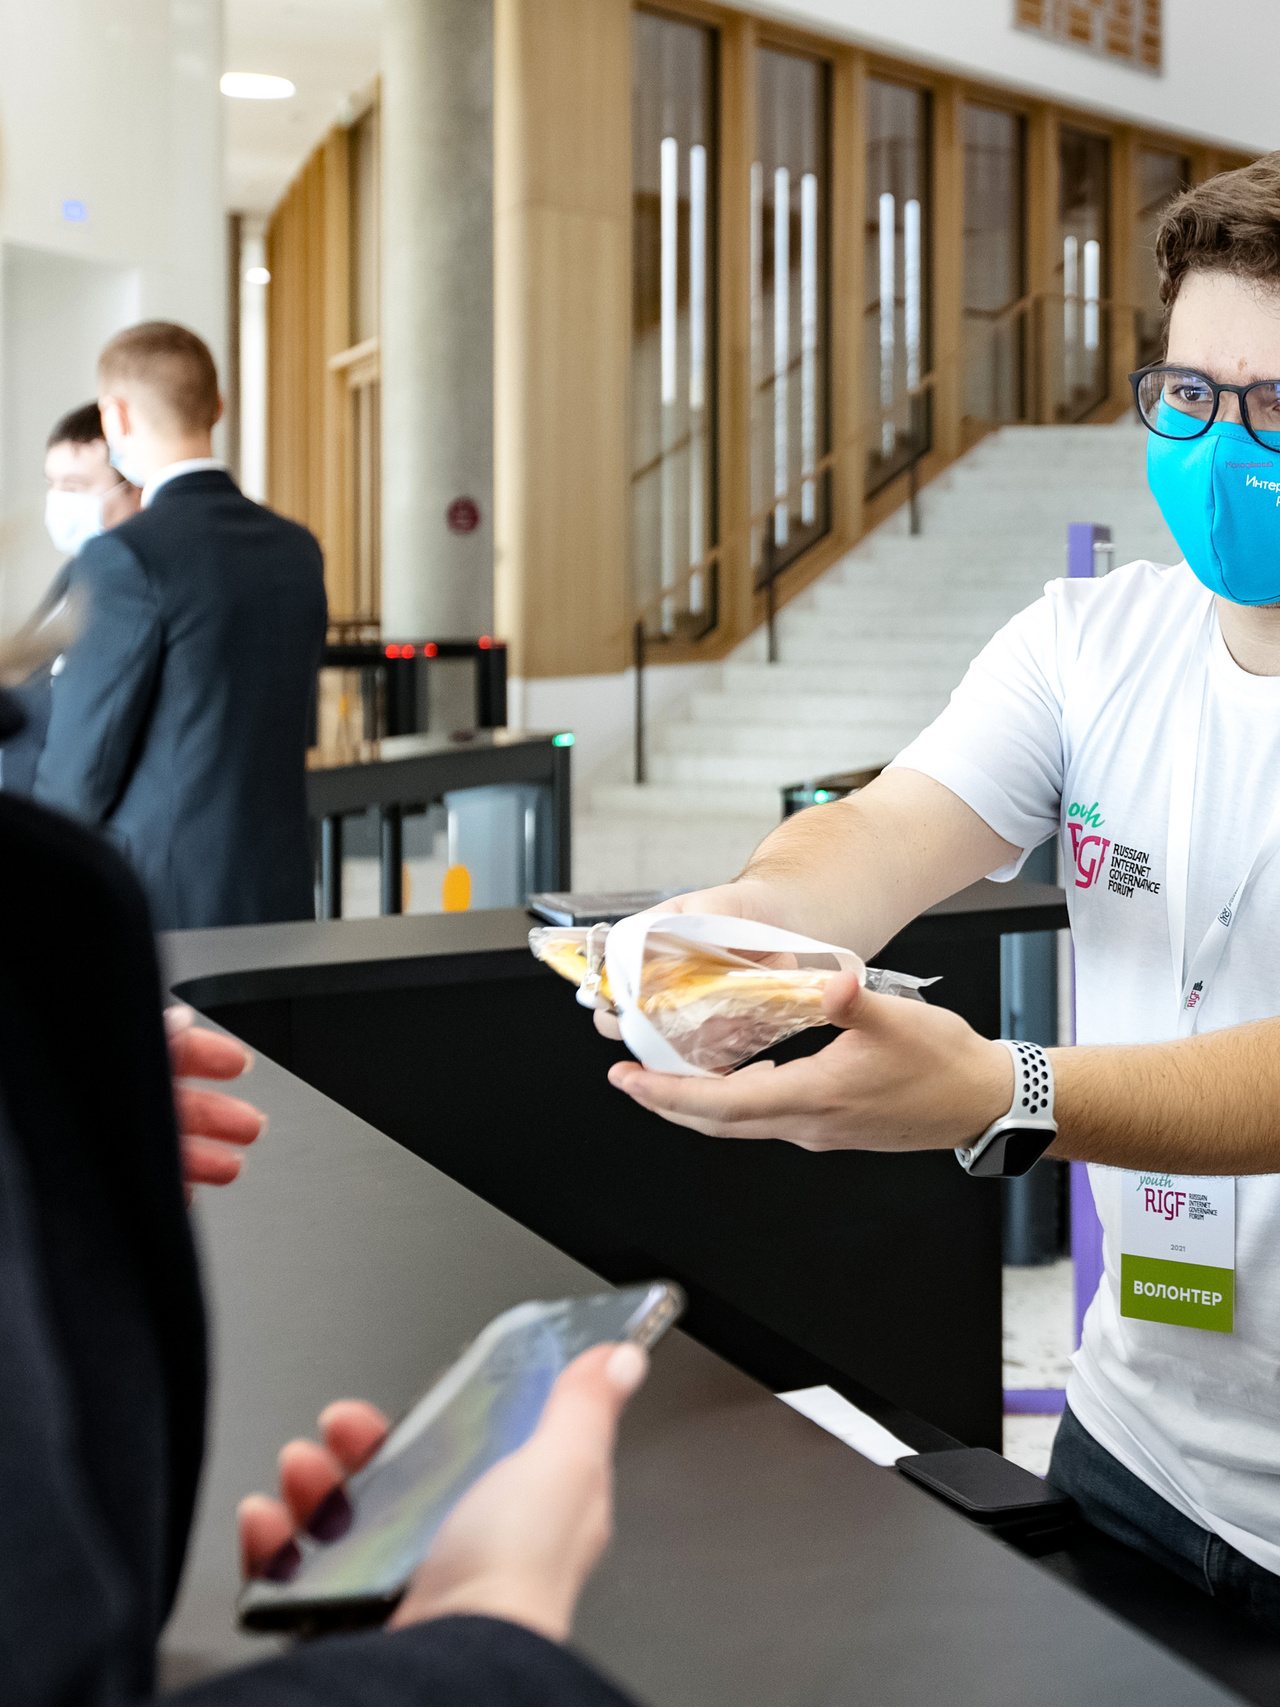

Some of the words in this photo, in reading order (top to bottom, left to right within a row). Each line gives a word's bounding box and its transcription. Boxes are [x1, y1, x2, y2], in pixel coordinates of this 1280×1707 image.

[1113, 843, 1149, 864] RUSSIAN
[1110, 856, 1151, 878] INTERNET
[1107, 880, 1134, 898] FORUM
[1109, 868, 1161, 894] GOVERNANCE
[1136, 1173, 1174, 1191] youth
[1144, 1187, 1187, 1221] RIGF
[1170, 1244, 1186, 1252] 2021
[1133, 1280, 1223, 1306] ВОЛОНТЕР
